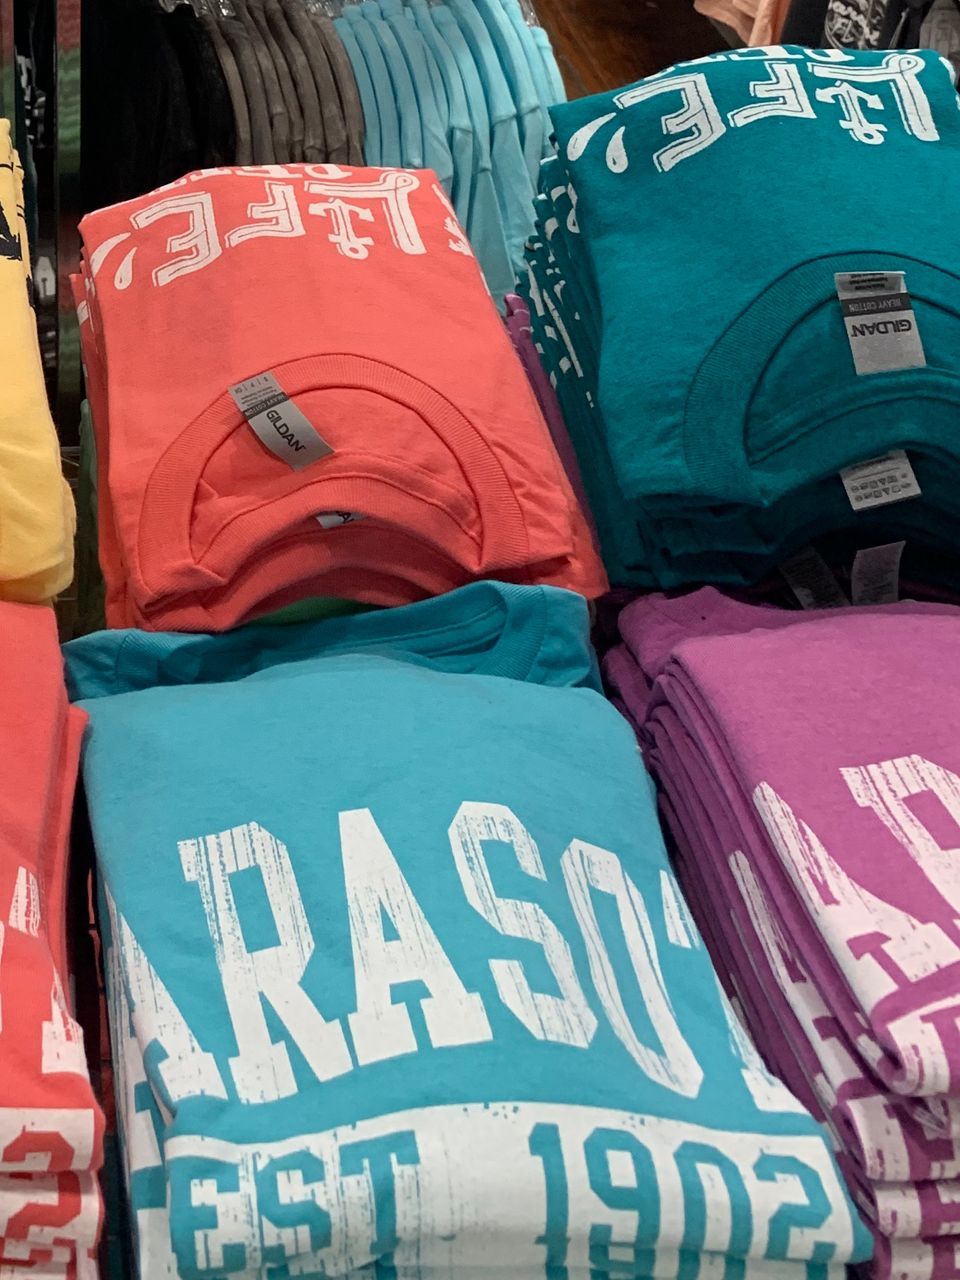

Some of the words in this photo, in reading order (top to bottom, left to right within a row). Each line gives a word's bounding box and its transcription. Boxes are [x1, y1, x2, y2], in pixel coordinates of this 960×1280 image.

[851, 318, 912, 338] GILDAN
[266, 409, 306, 452] GILDAN
[528, 1121, 835, 1264] 1902
